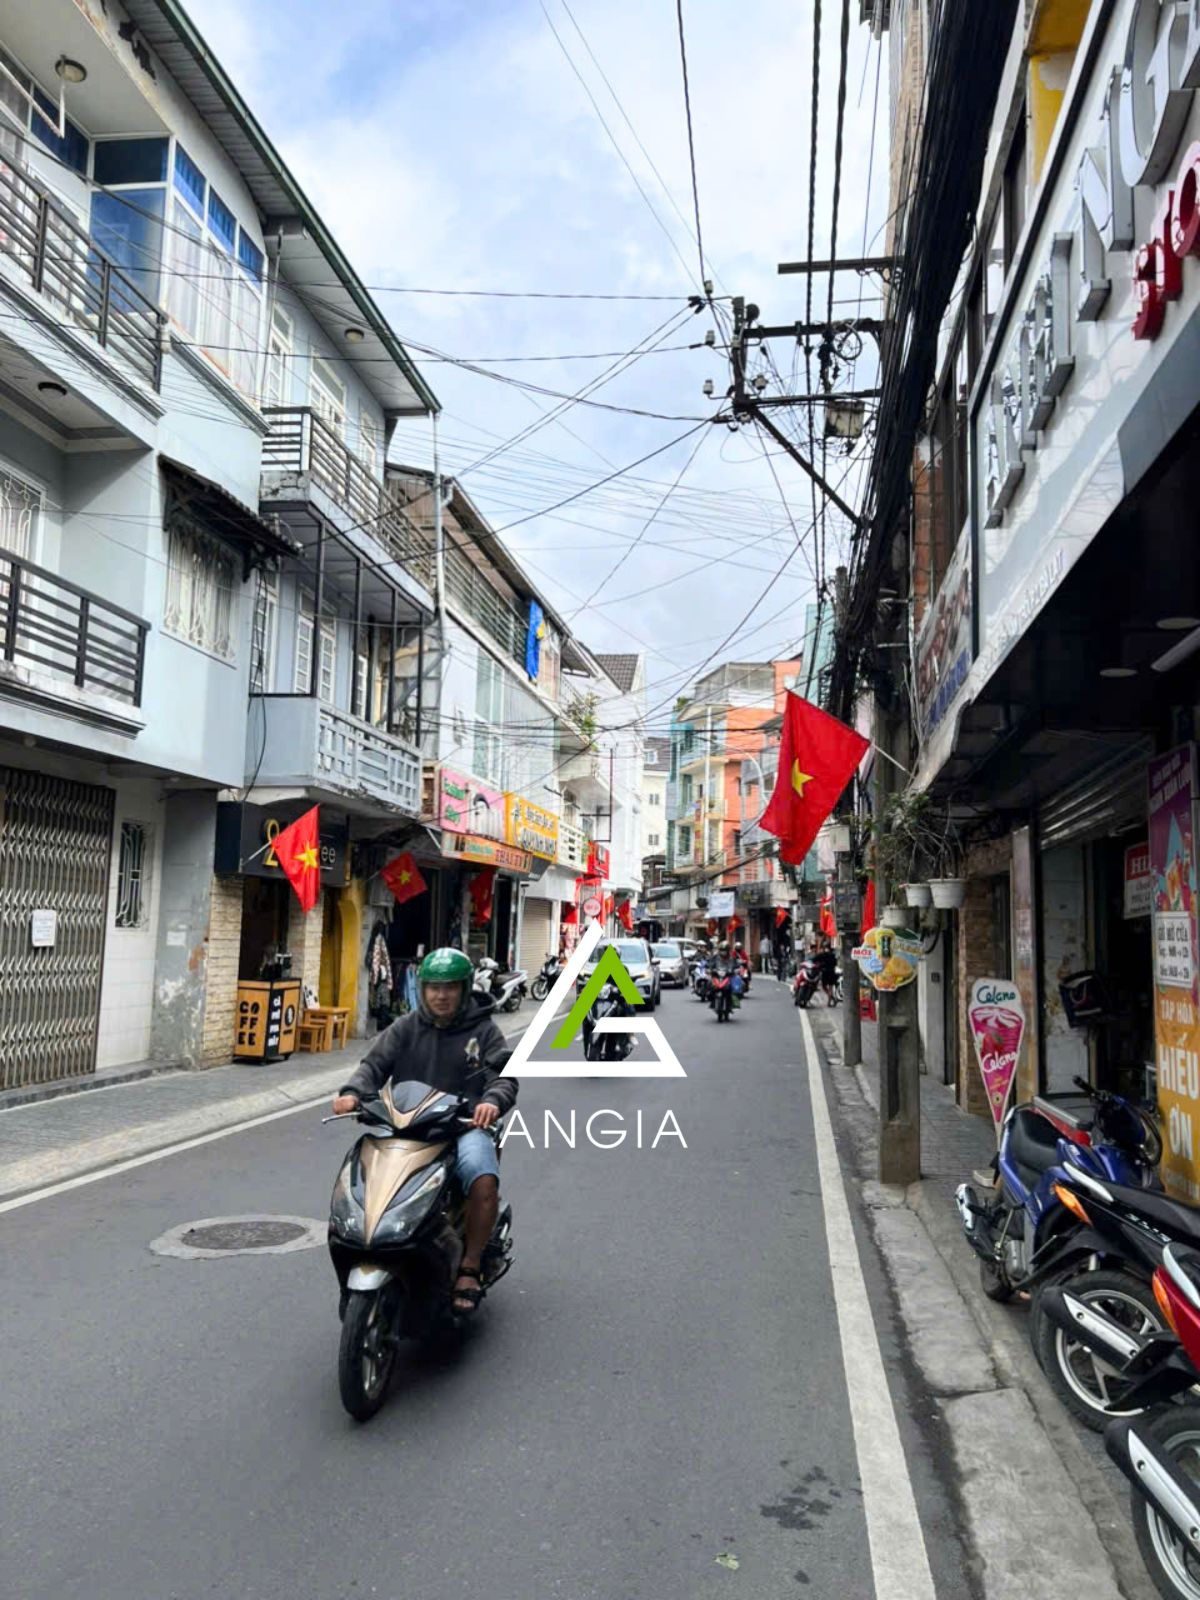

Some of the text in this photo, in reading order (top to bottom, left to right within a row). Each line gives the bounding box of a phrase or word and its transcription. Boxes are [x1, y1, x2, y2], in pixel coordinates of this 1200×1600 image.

[976, 985, 1016, 1005] Celano
[981, 1050, 1018, 1073] Celano
[1159, 1031, 1199, 1100] HIẾU
